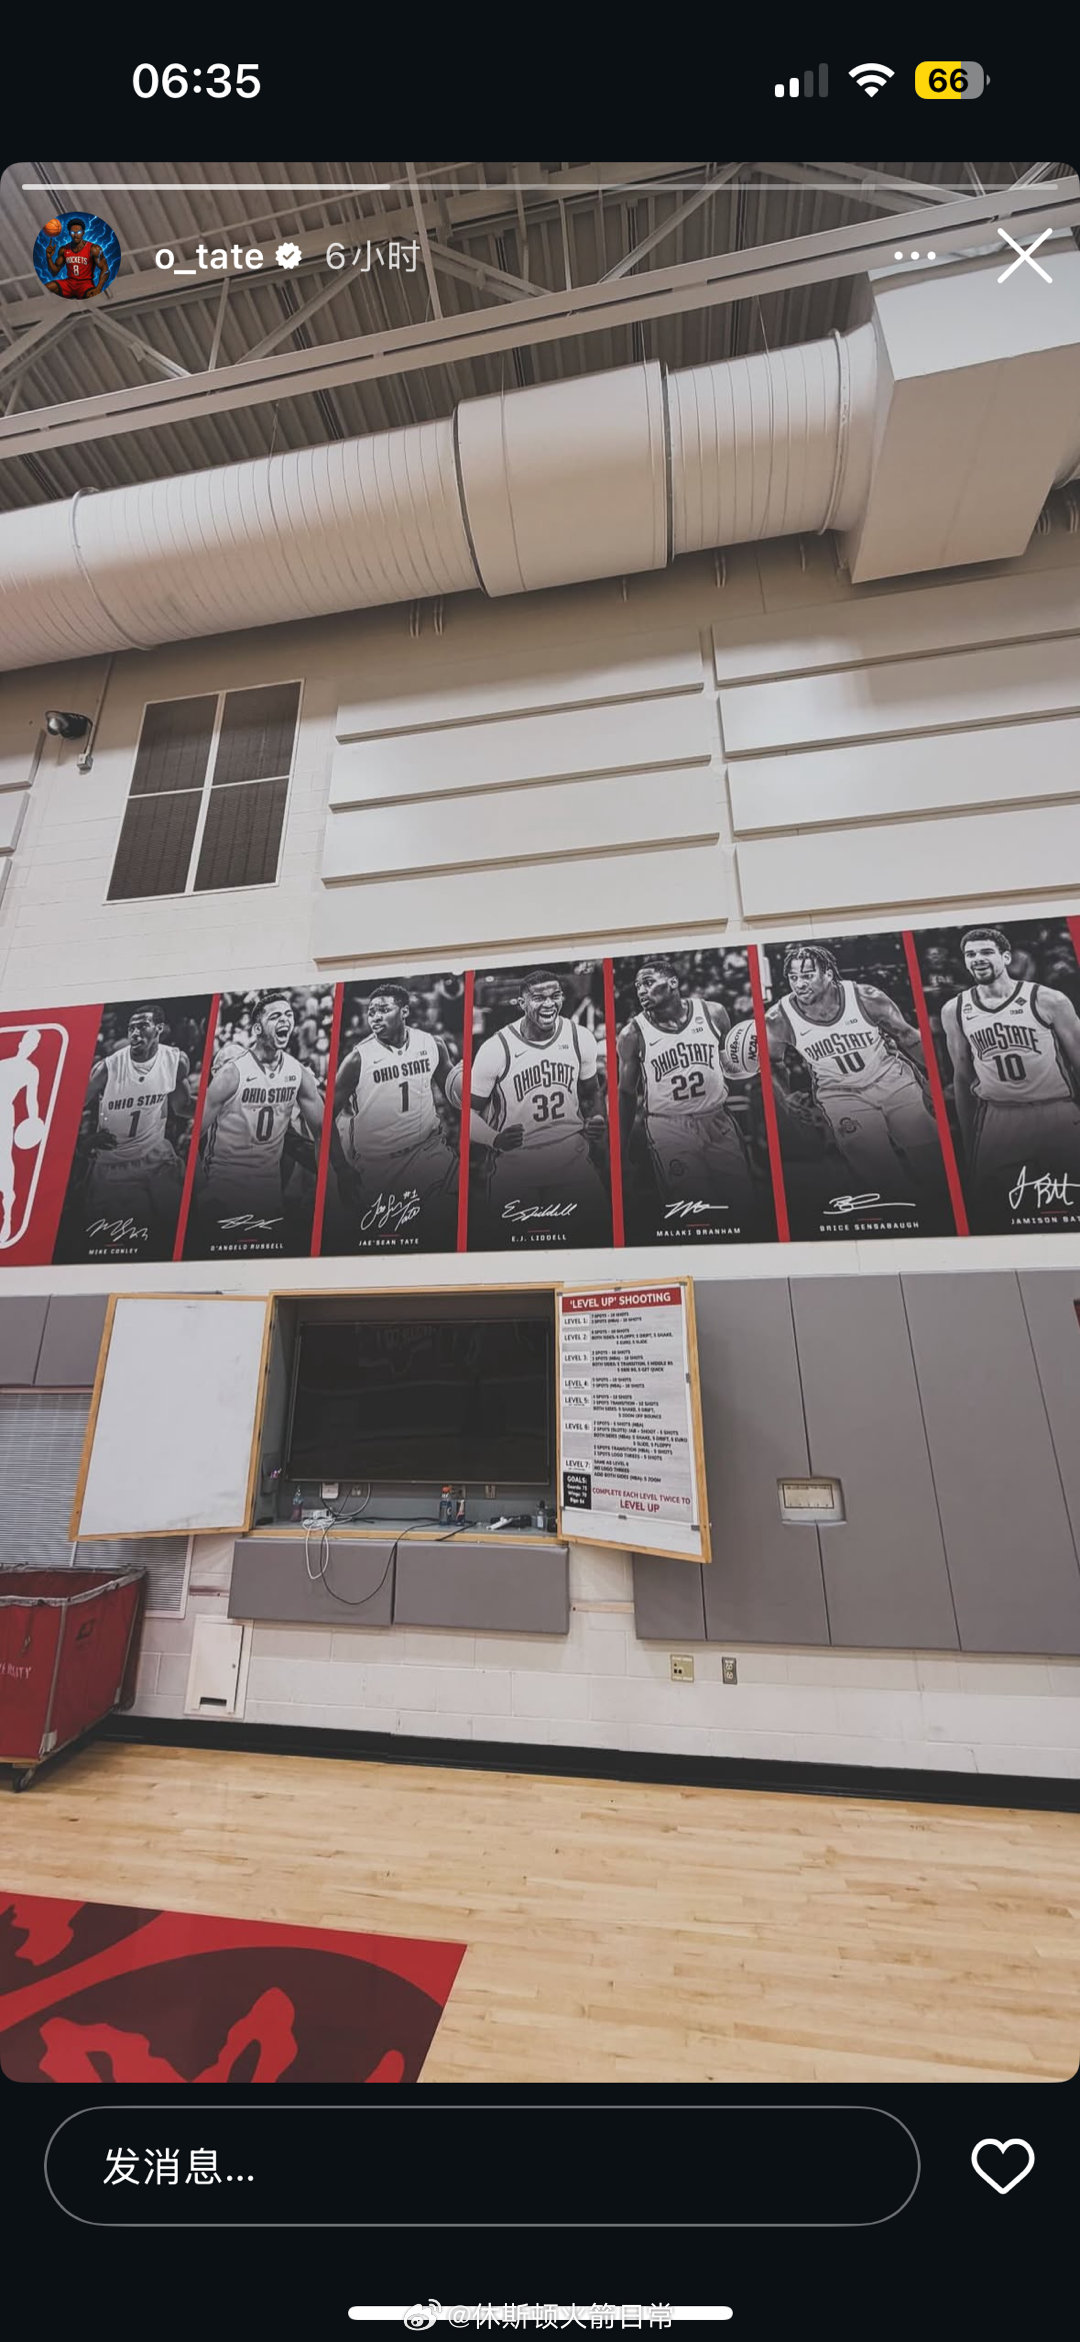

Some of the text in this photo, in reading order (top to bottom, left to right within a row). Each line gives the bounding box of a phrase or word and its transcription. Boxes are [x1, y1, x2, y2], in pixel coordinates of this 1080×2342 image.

[373, 1058, 431, 1083] OHIO STATE
[832, 1052, 866, 1075] 10
[993, 1053, 1026, 1082] 10
[671, 1071, 706, 1101] 22
[241, 1087, 267, 1103] OHIO
[398, 1081, 409, 1113] 1
[108, 1097, 133, 1111] OHIO
[532, 1091, 565, 1122] 32
[128, 1110, 141, 1138] 1
[256, 1106, 274, 1142] 0
[819, 1222, 920, 1232] BRICE SENSABAUGH
[1011, 1217, 1058, 1225] JAMISON
[656, 1228, 741, 1237] MALAKI BRANHAM
[570, 1293, 671, 1308] 'LEVEL UP' SHOOTING
[565, 1396, 581, 1404] LEVEL
[593, 1488, 690, 1505] COMPLETE EACH LEVEL TWICE TO
[620, 1499, 660, 1512] LEVEL UP
